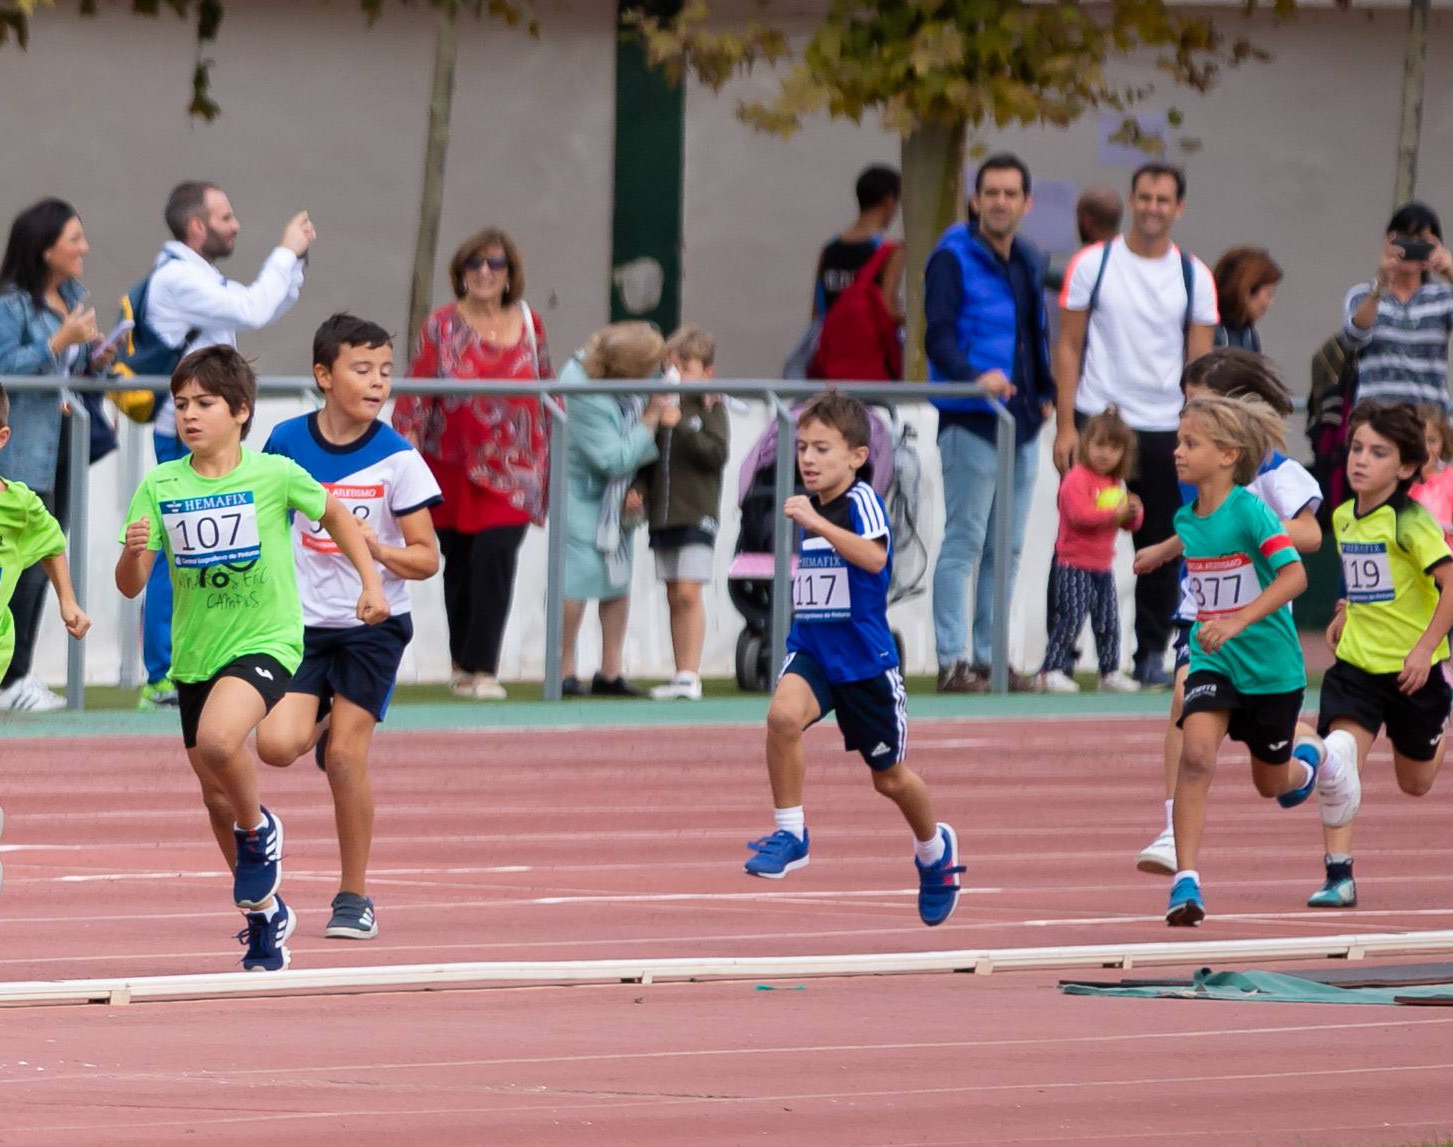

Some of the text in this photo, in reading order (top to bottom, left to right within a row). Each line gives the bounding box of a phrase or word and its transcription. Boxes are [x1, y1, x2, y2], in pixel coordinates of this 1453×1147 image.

[185, 492, 246, 511] HEMAFIX
[333, 488, 376, 497] ATLETISMO
[176, 513, 243, 551] 107
[796, 574, 837, 606] 117
[1191, 573, 1241, 607] 377
